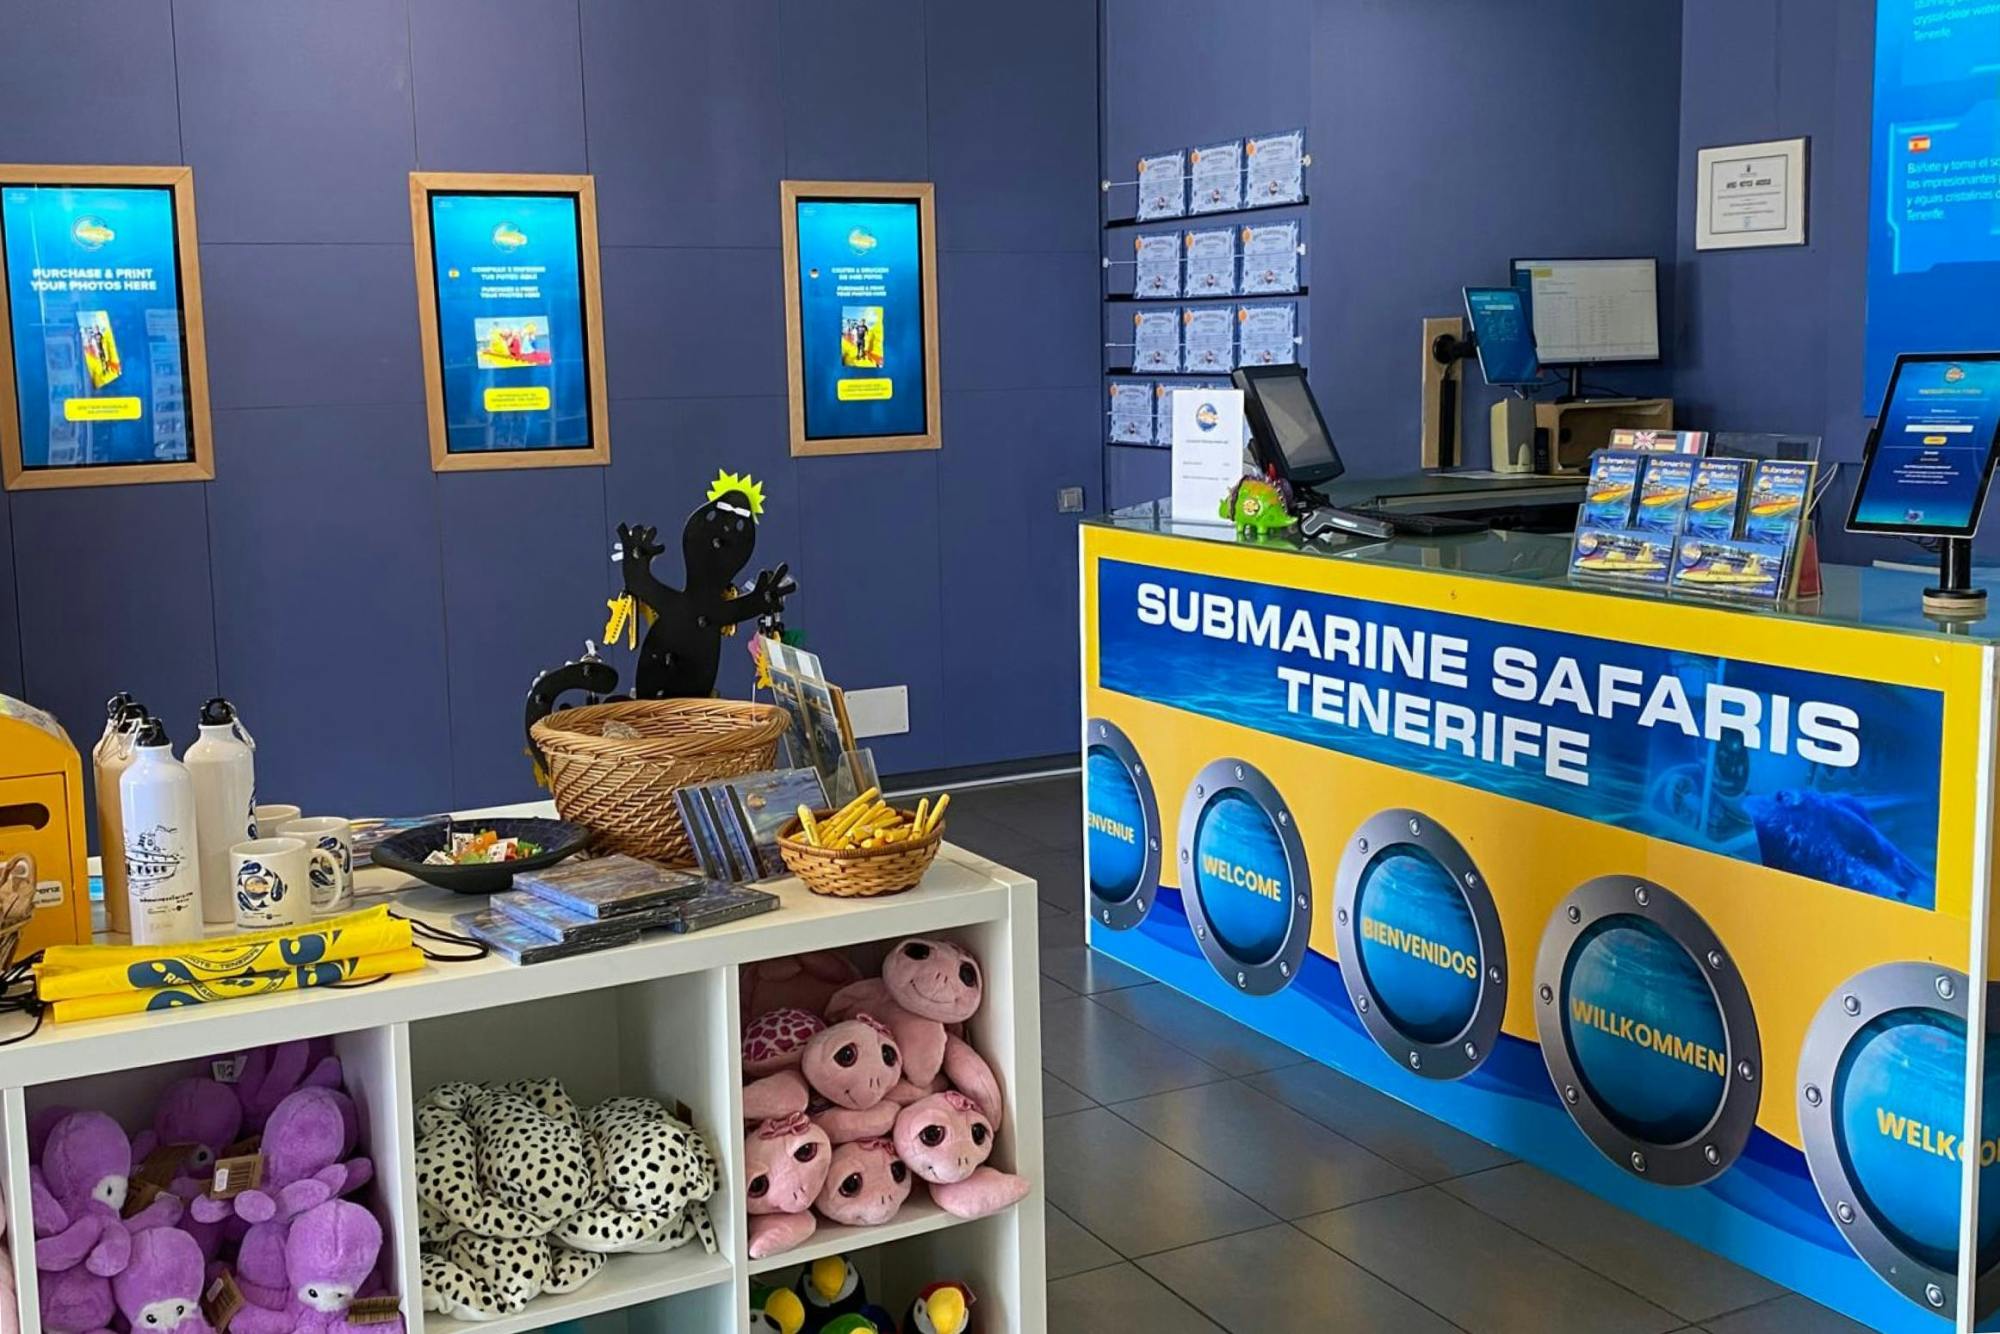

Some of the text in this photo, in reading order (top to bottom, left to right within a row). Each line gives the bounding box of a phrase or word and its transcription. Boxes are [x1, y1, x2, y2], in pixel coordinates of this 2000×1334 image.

[30, 280, 157, 291] YOUR PHOTOS HERE
[32, 268, 153, 279] PURCHASE & PRINT
[1137, 583, 1860, 767] SUBMARINE SAFARIS
[1277, 666, 1590, 786] TENERIFE
[1203, 854, 1282, 902] WELCOME
[1359, 913, 1477, 979] BIENVENIDOS
[1571, 996, 1726, 1077] WILLKOMMEN
